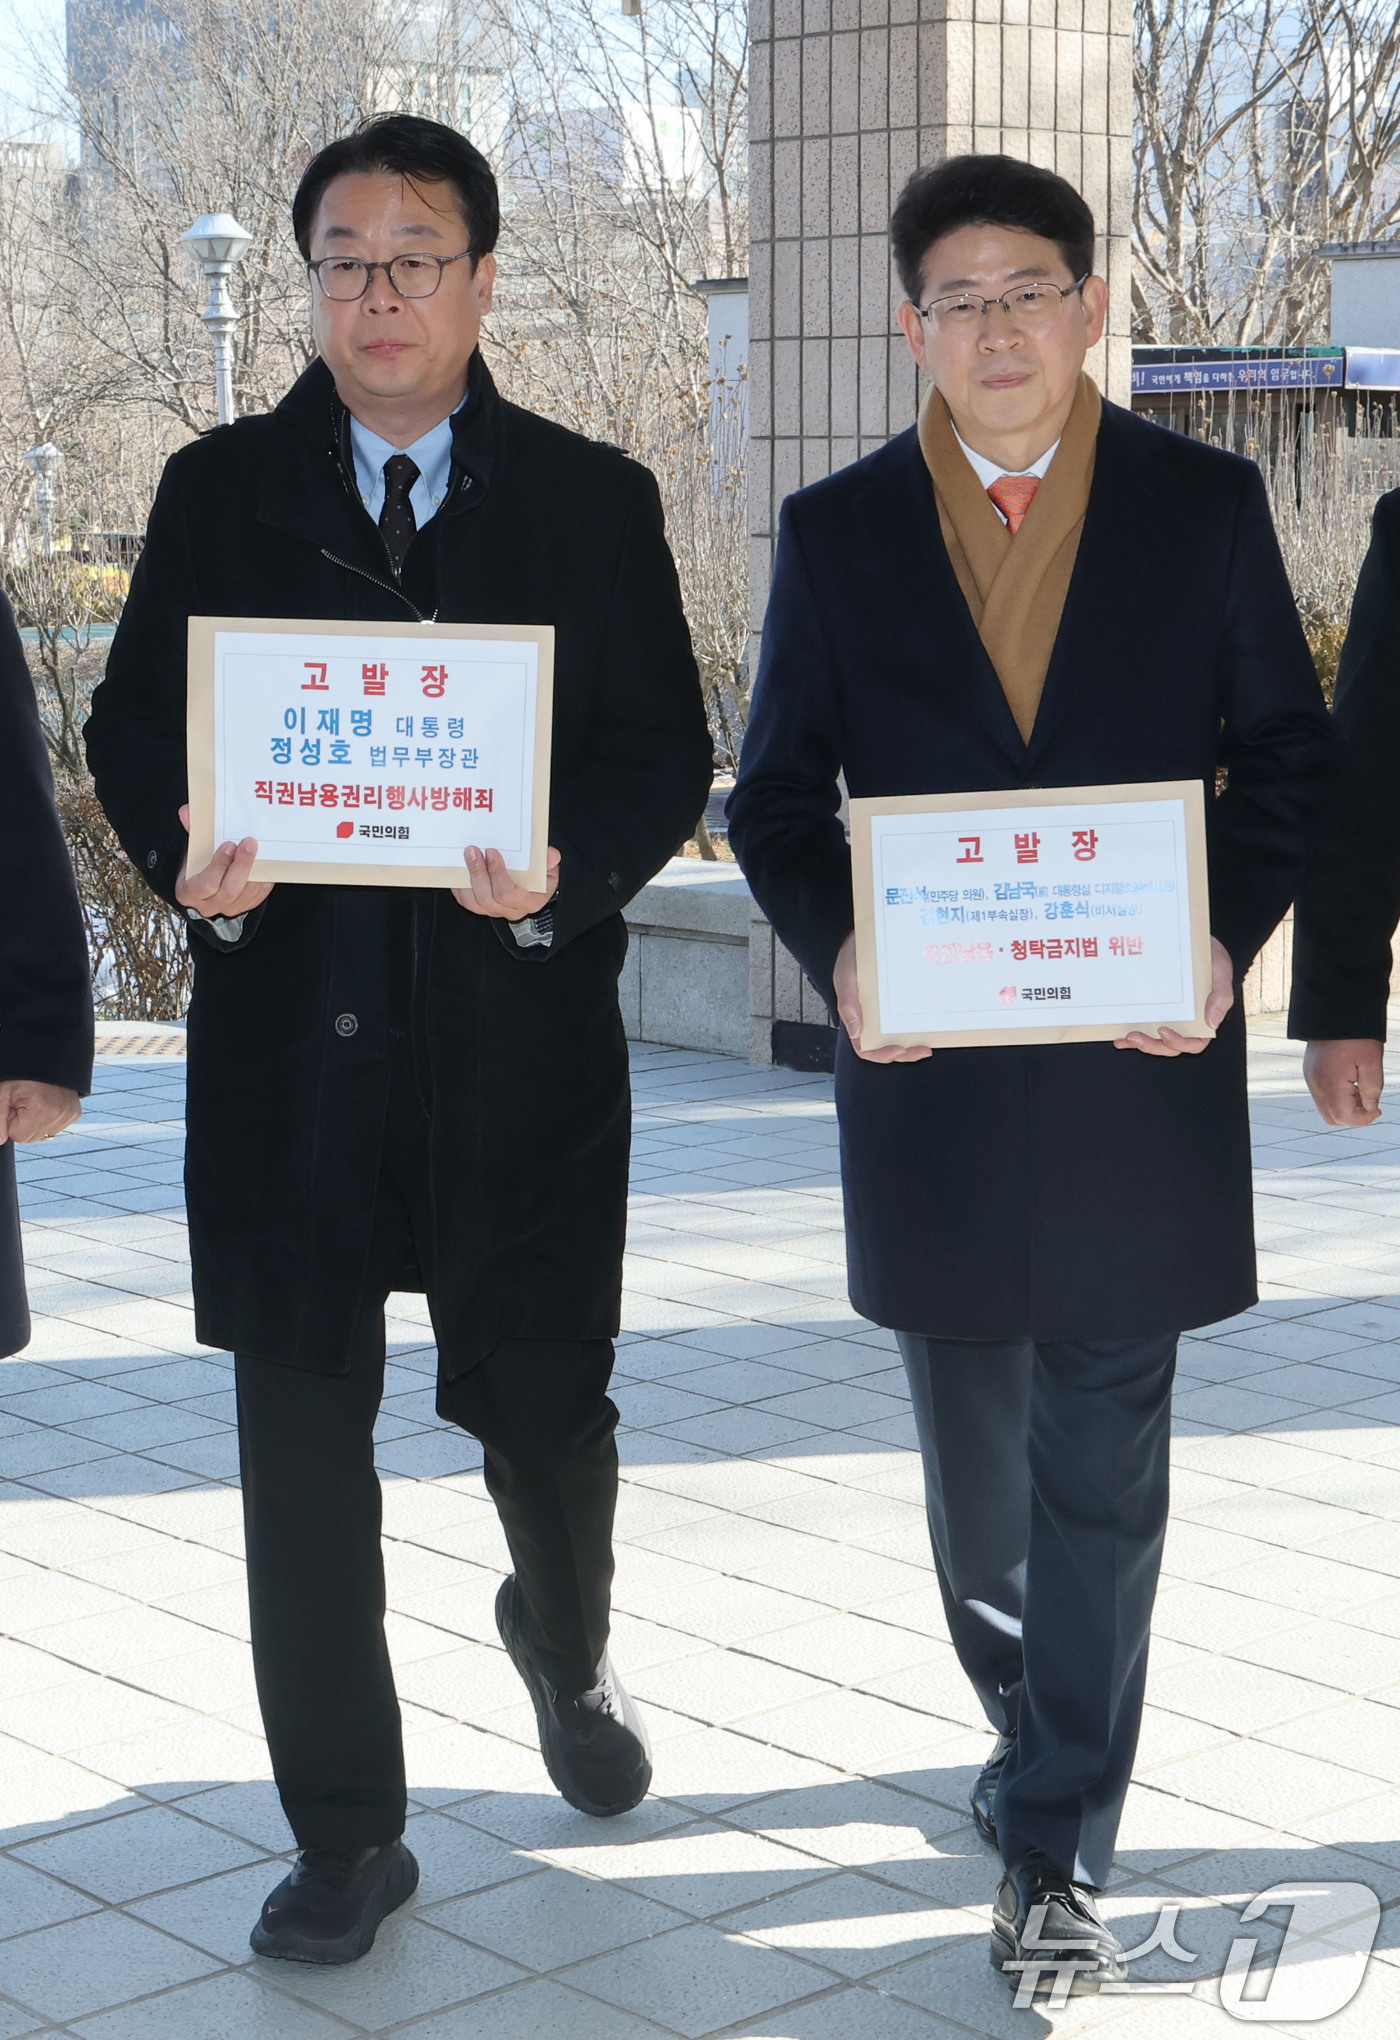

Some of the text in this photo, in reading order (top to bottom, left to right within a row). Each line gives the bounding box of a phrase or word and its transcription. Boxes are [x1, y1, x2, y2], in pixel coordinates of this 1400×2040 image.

[1152, 373, 1181, 385] 국민에게
[1184, 370, 1210, 384] 책임을
[1238, 368, 1267, 382] 우리의
[284, 706, 465, 739] 이재명 대통령
[270, 736, 479, 769] 정성호 법무부장관
[254, 780, 494, 813] 직권남용권리행사방해죄
[358, 824, 410, 840] 국민의힘
[1052, 883, 1091, 897] 대통령실
[1108, 934, 1144, 957] 위반
[1021, 986, 1072, 1001] 국민의힘
